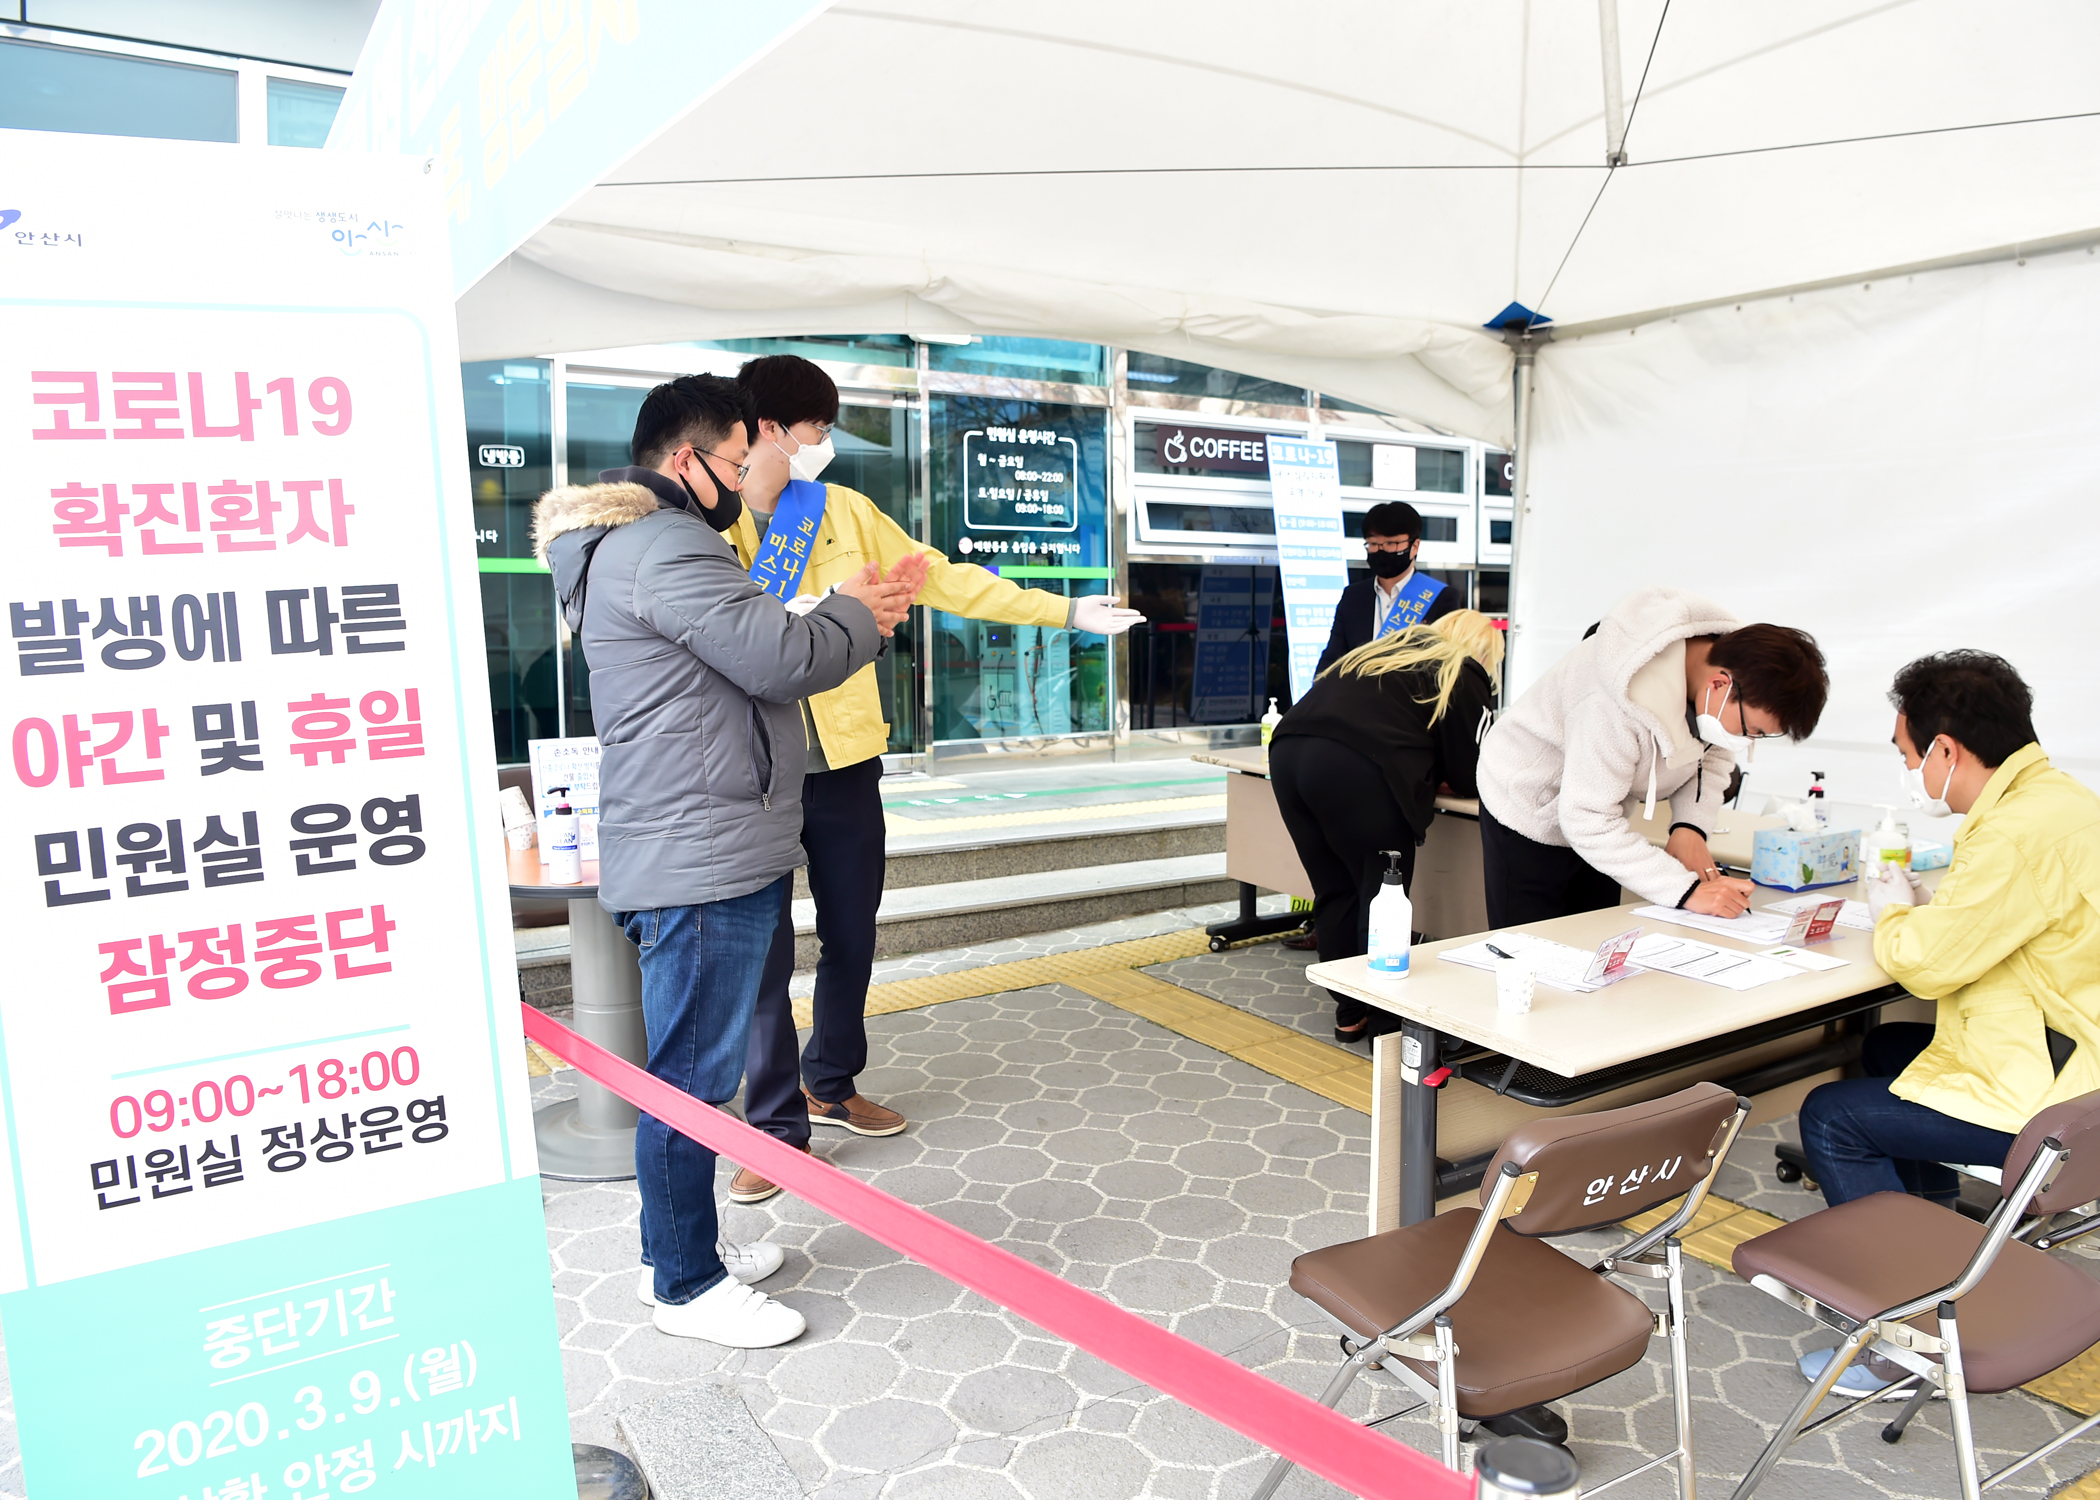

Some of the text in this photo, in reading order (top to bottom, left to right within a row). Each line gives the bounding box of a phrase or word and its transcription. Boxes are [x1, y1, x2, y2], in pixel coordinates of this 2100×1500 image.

[14, 230, 83, 248] 안산시
[315, 211, 359, 224] 생생도시
[31, 370, 353, 442] 코로나19
[1189, 436, 1264, 462] COFFEE
[50, 478, 355, 558] 확진환자
[9, 583, 407, 677] 발생에 따른
[11, 687, 426, 788] 야간 및 휴일
[34, 794, 426, 908] 민원실 운영
[98, 904, 396, 1015] 잠정중단
[109, 1045, 420, 1139] 09:00~18:00
[90, 1095, 450, 1210] 민원실 정상운영
[203, 1278, 396, 1370] 중단기간
[282, 1439, 376, 1500] 안정
[393, 1397, 521, 1473] 시까지
